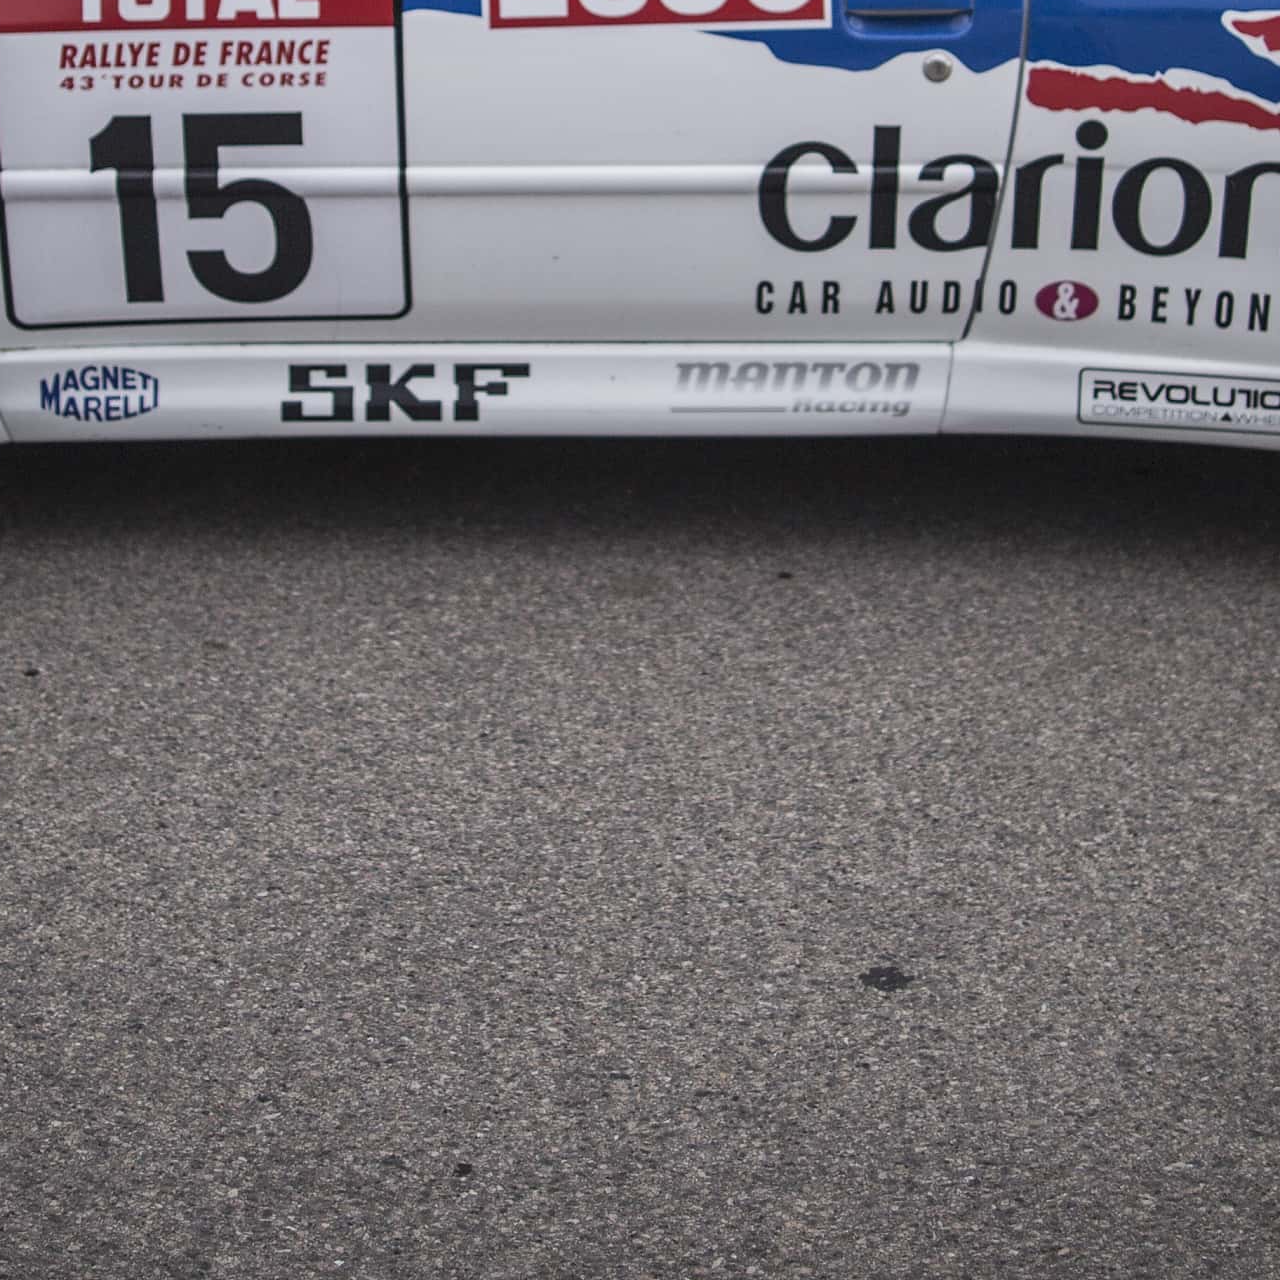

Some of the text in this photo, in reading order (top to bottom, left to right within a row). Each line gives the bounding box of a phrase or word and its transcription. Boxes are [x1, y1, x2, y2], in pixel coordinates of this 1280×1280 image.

[59, 39, 330, 69] RALLYE DE FRANCE
[112, 73, 184, 89] TOUR
[196, 72, 229, 88] DE
[241, 71, 327, 87] CORSE
[89, 111, 314, 304] 15
[755, 280, 841, 315] CAR
[876, 280, 1018, 315] AUDIO
[40, 365, 159, 416] MAGNETI
[281, 363, 530, 422] SKF
[1092, 404, 1217, 422] COMPETITION
